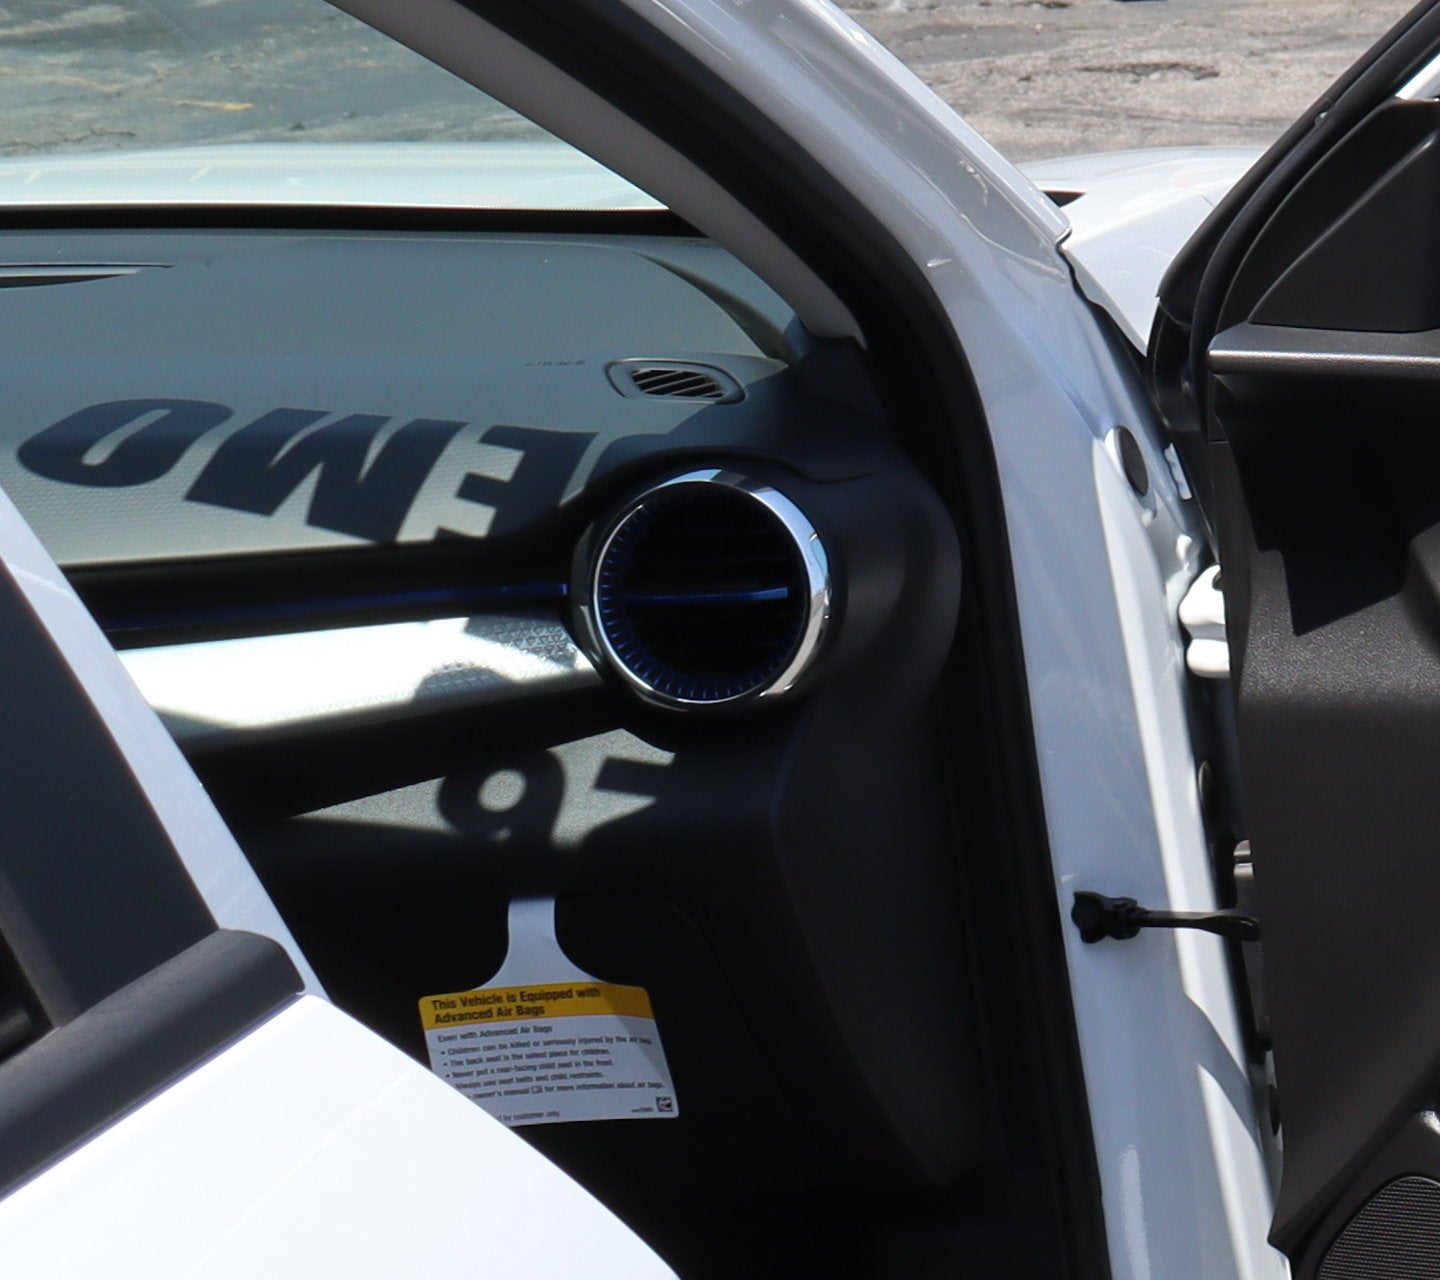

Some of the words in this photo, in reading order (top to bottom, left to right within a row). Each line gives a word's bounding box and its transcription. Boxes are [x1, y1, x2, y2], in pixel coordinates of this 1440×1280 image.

[433, 998, 457, 1011] This
[460, 994, 503, 1008] Vehicle
[506, 992, 516, 1004] is
[519, 988, 573, 1004] Equipped
[577, 987, 602, 1000] with
[434, 1007, 494, 1025] Advanced
[496, 1004, 514, 1017] Air
[516, 1003, 546, 1018] Bags
[438, 1034, 458, 1043] Even
[460, 1031, 478, 1040] with
[479, 1025, 518, 1038] Advanced
[520, 1024, 532, 1035] Air
[533, 1024, 553, 1035] Bags
